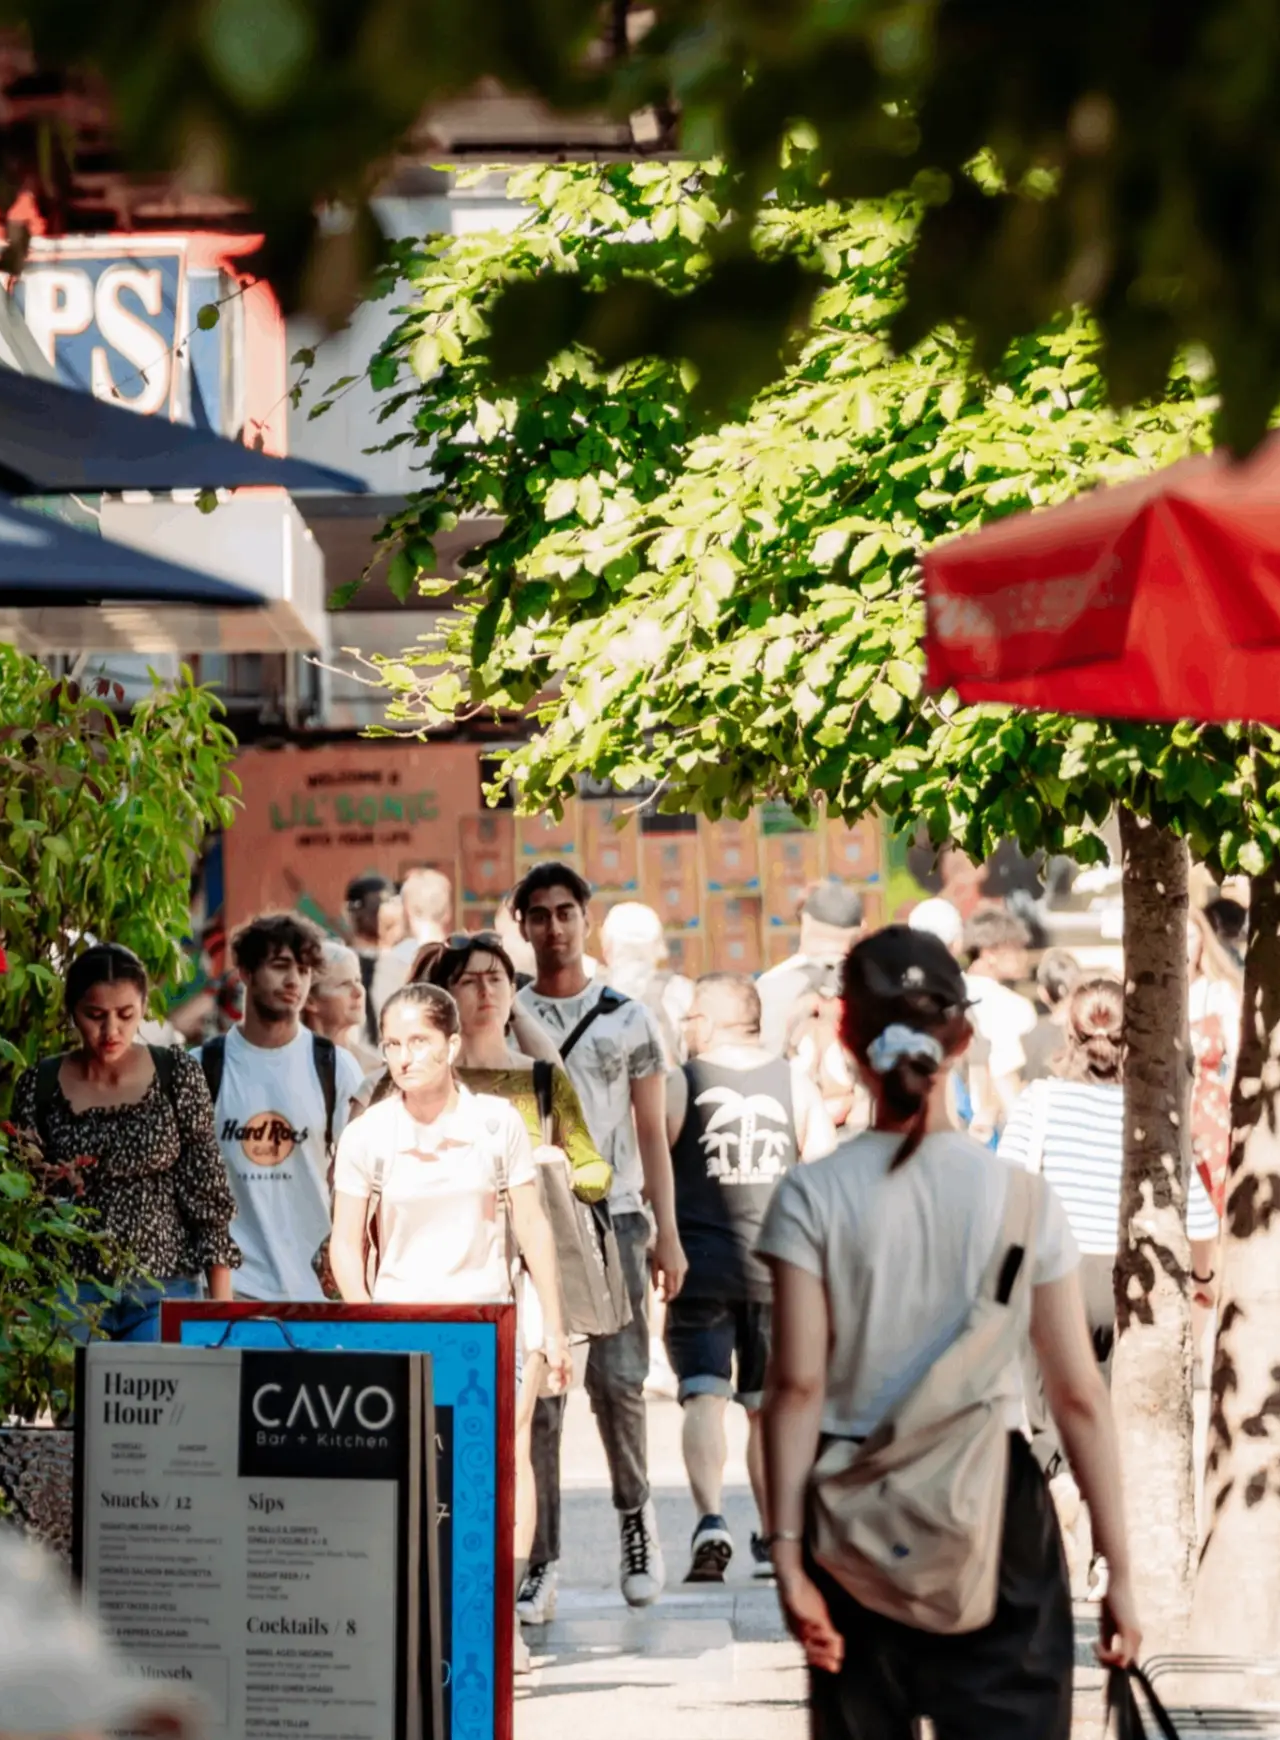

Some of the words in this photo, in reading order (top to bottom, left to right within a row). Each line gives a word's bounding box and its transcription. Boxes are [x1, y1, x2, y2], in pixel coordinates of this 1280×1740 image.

[221, 1119, 268, 1141] Hard
[103, 1372, 179, 1402] Happy
[103, 1401, 164, 1426] Hour
[252, 1383, 395, 1430] CAVO
[256, 1431, 288, 1446] Bar
[316, 1433, 389, 1449] Kitchen
[100, 1490, 160, 1509] Snacks
[175, 1496, 192, 1510] 12
[248, 1492, 285, 1514] Sips
[246, 1615, 329, 1636] Cocktails
[346, 1618, 357, 1636] 8
